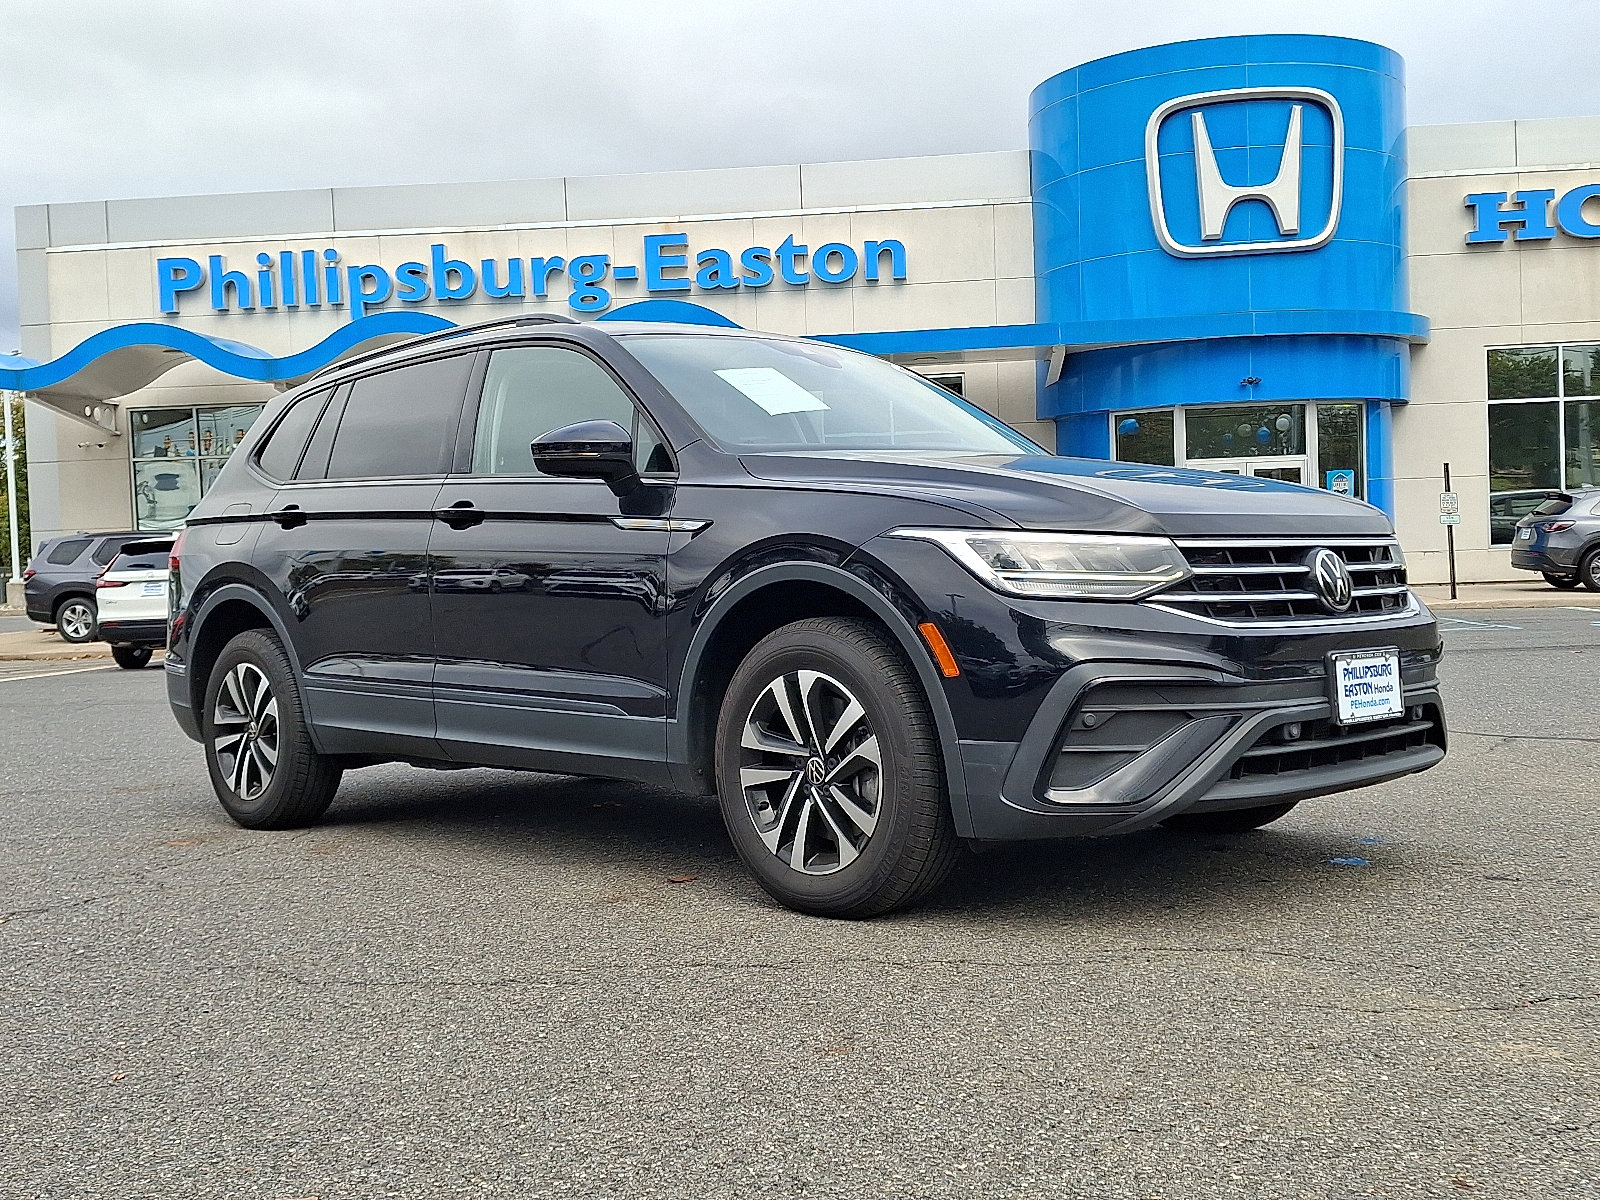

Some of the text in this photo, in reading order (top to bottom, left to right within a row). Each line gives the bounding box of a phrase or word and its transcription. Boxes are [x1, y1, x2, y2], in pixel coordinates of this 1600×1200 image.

[157, 233, 907, 320] Phillipsburg-Easton
[1342, 664, 1393, 681] PHILLIPSBURG
[1343, 682, 1394, 698] EASTON Honda
[1350, 697, 1391, 709] PEHonda.com
